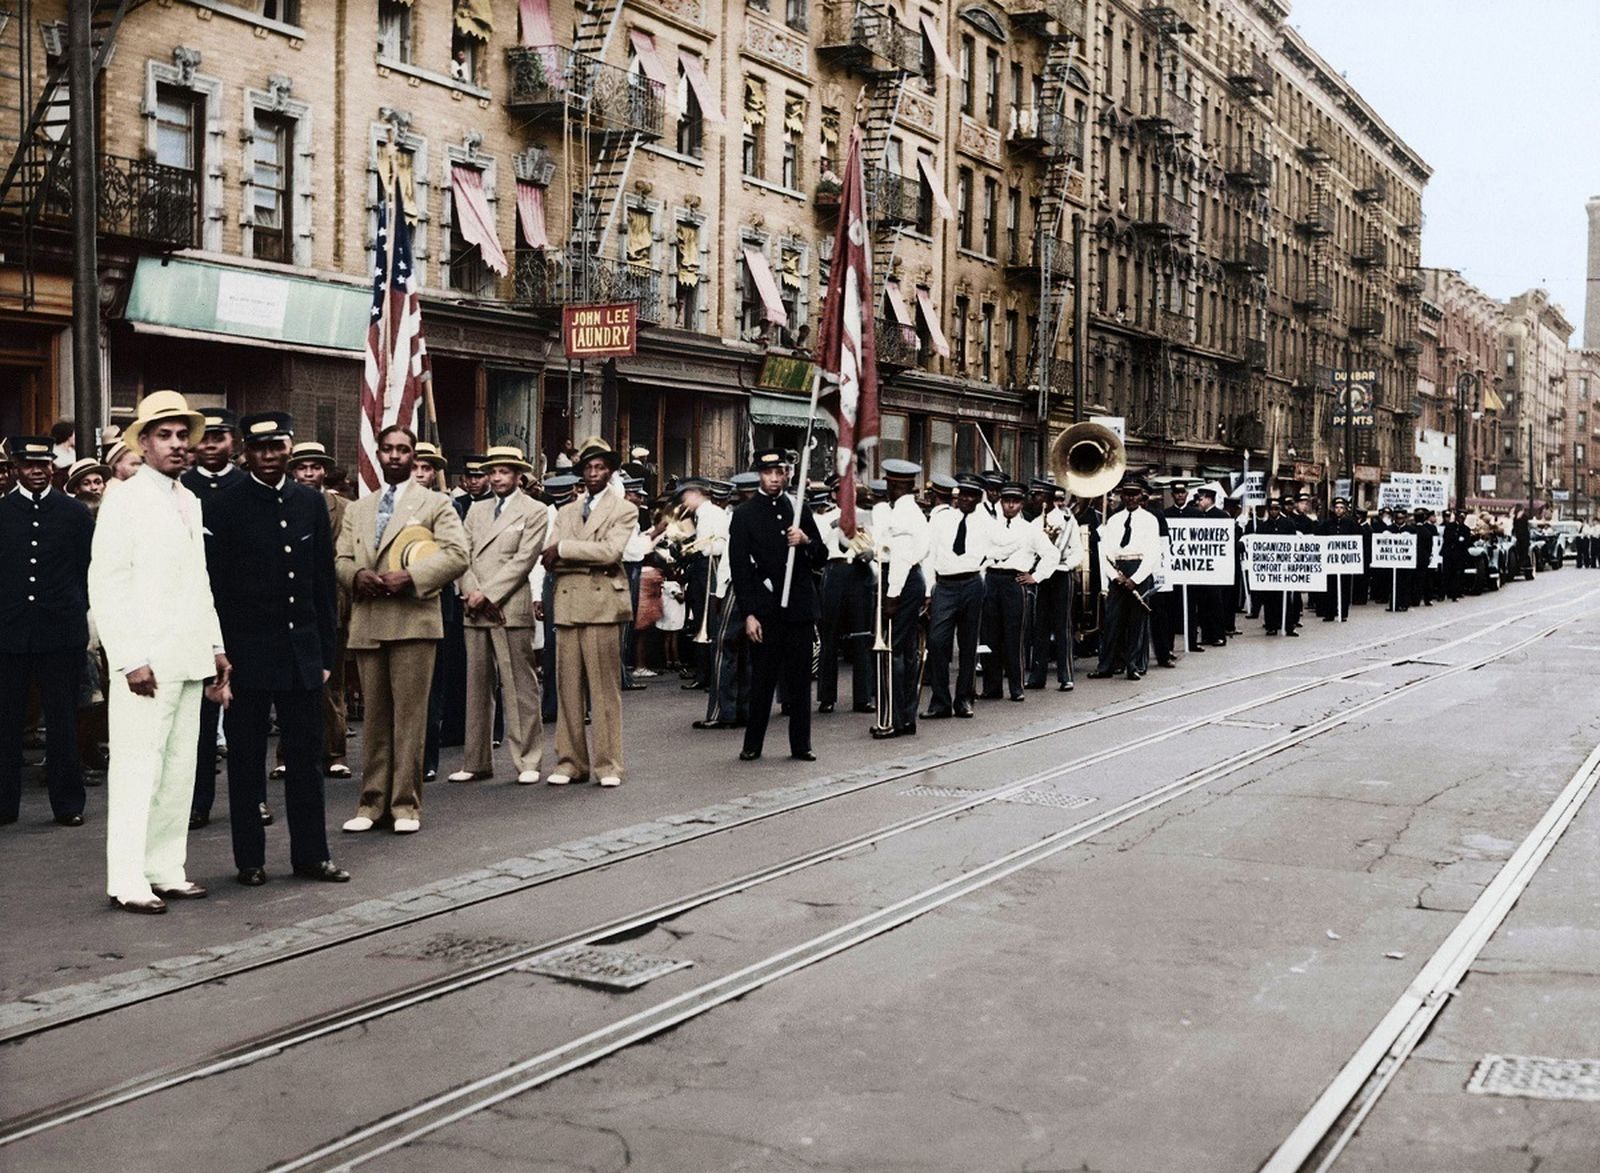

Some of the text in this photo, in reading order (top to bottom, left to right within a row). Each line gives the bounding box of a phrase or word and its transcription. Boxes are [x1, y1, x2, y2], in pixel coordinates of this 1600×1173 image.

[572, 309, 630, 326] JOHN LEE
[572, 326, 631, 352] LAUNDRY
[1333, 416, 1373, 425] PANTS
[1168, 528, 1230, 541] TIC WORKERS
[1177, 544, 1186, 556] &
[1188, 544, 1226, 556] WHITE
[1252, 541, 1321, 552] ORGANIZED LABOR
[1252, 553, 1322, 563] BRINGS MORE SUNSHINE
[1340, 553, 1361, 564] QUITS
[1252, 564, 1281, 572] COMFORT
[1287, 563, 1322, 573] HAPPINESS
[1256, 574, 1311, 583] TO THE HOME
